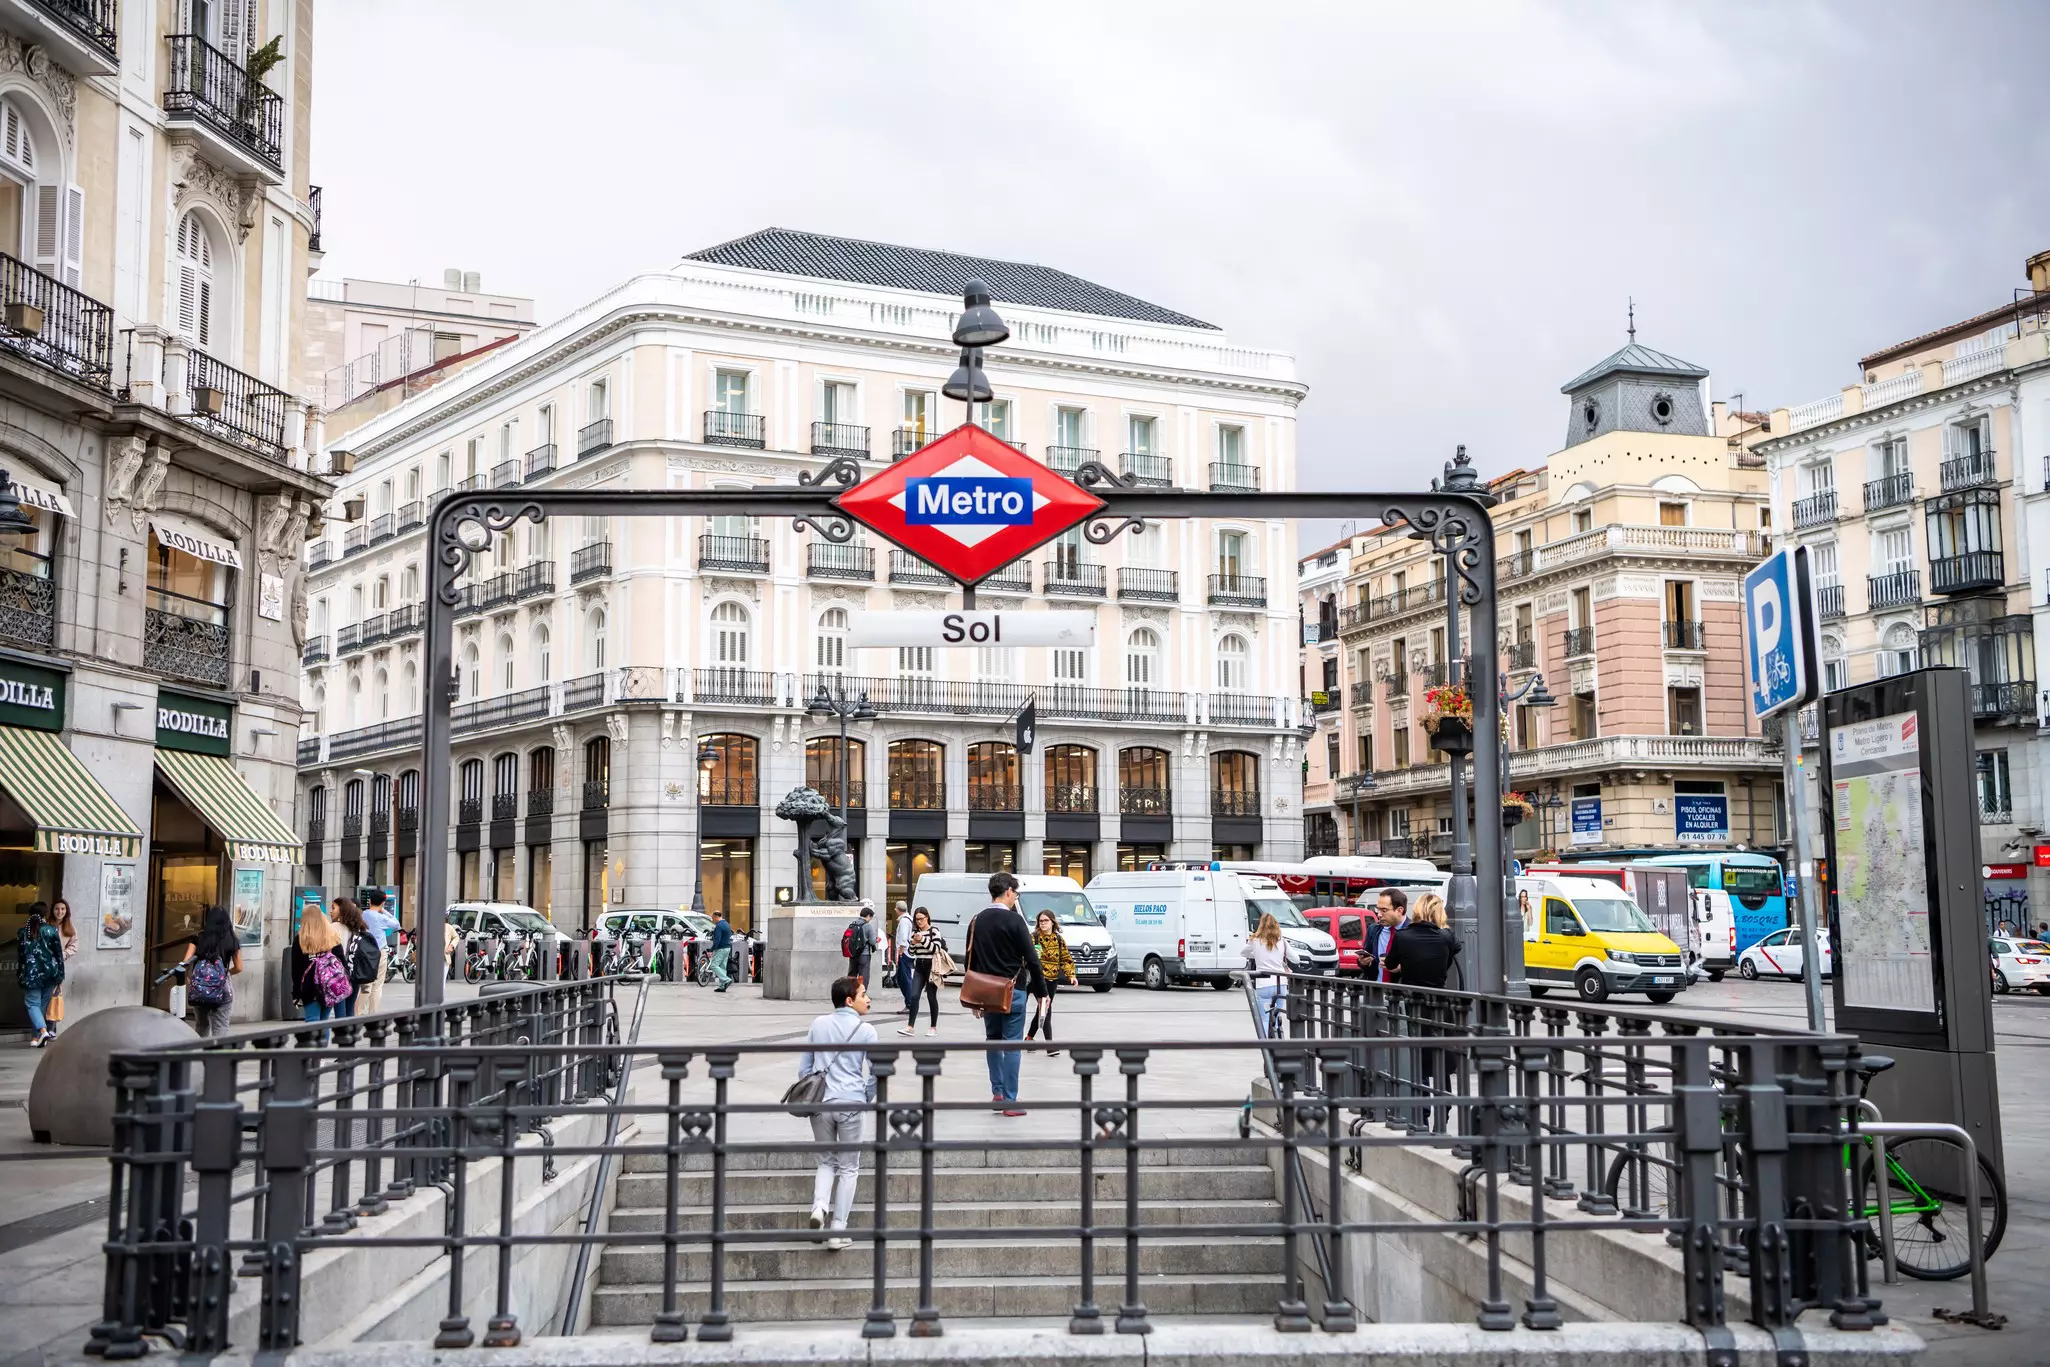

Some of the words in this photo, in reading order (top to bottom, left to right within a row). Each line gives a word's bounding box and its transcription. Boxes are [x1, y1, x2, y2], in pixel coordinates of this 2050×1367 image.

[10, 481, 63, 512] ILLA
[917, 484, 1024, 515] Metro
[161, 528, 238, 566] RODILLA
[942, 614, 1001, 643] Sol
[1753, 578, 1782, 697] P
[158, 707, 228, 739] RODILLA
[1852, 727, 1867, 736] Plano
[1868, 724, 1875, 732] de
[1855, 736, 1870, 746] Metro
[1872, 734, 1888, 744] Ligero
[1681, 806, 1697, 814] PISOS,
[1698, 806, 1722, 814] OFICINAS
[1694, 821, 1719, 829] ALQUILER
[58, 835, 122, 856] RODILLA
[239, 845, 291, 863] RODILLA
[1175, 863, 1187, 871] 20
[1134, 904, 1152, 912] HIELOS
[1153, 904, 1167, 912] PACO
[1742, 915, 1779, 927] BOSQUE
